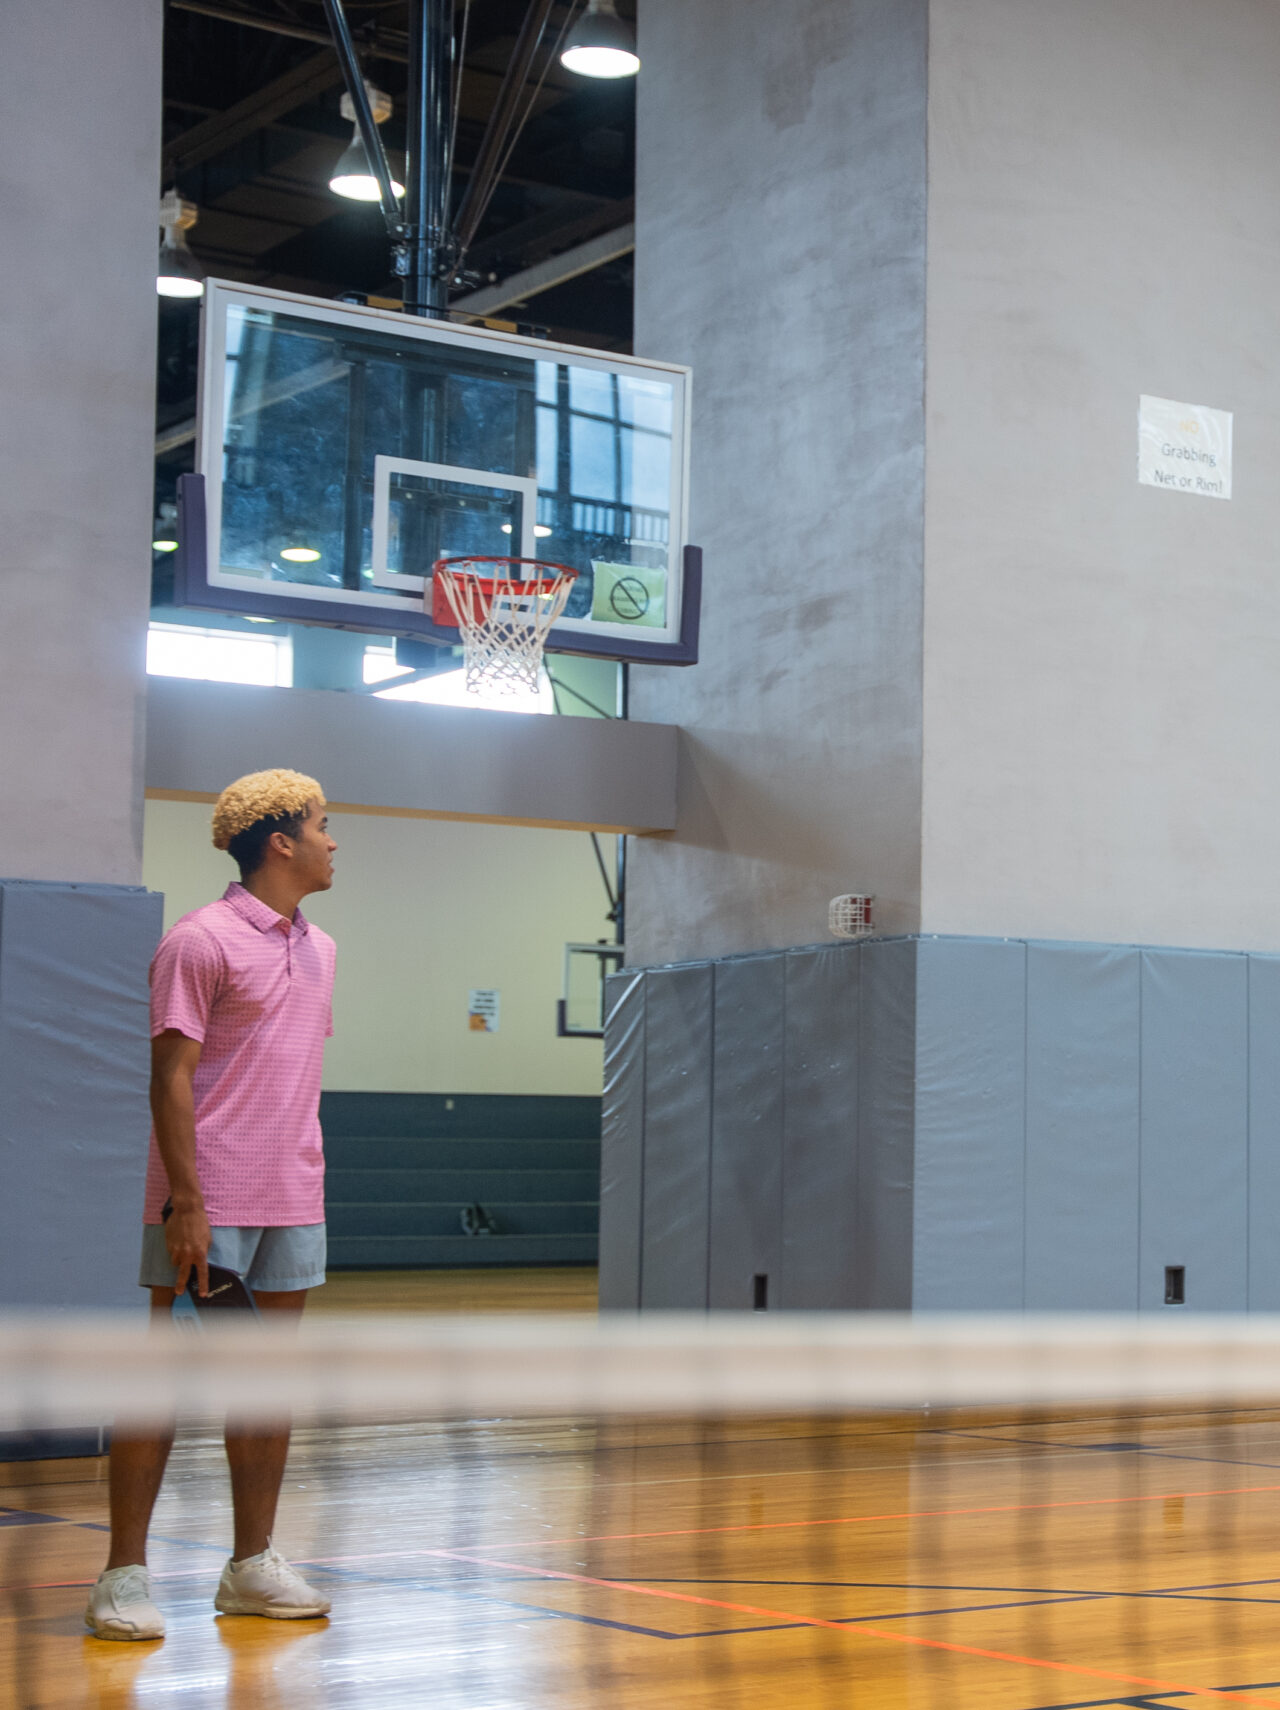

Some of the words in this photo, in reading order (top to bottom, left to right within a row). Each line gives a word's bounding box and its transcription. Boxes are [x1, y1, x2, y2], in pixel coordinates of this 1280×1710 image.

[1161, 443, 1217, 467] Grabbing
[1154, 470, 1176, 486] Net
[1179, 476, 1192, 488] or
[1196, 477, 1223, 493] Rim!
